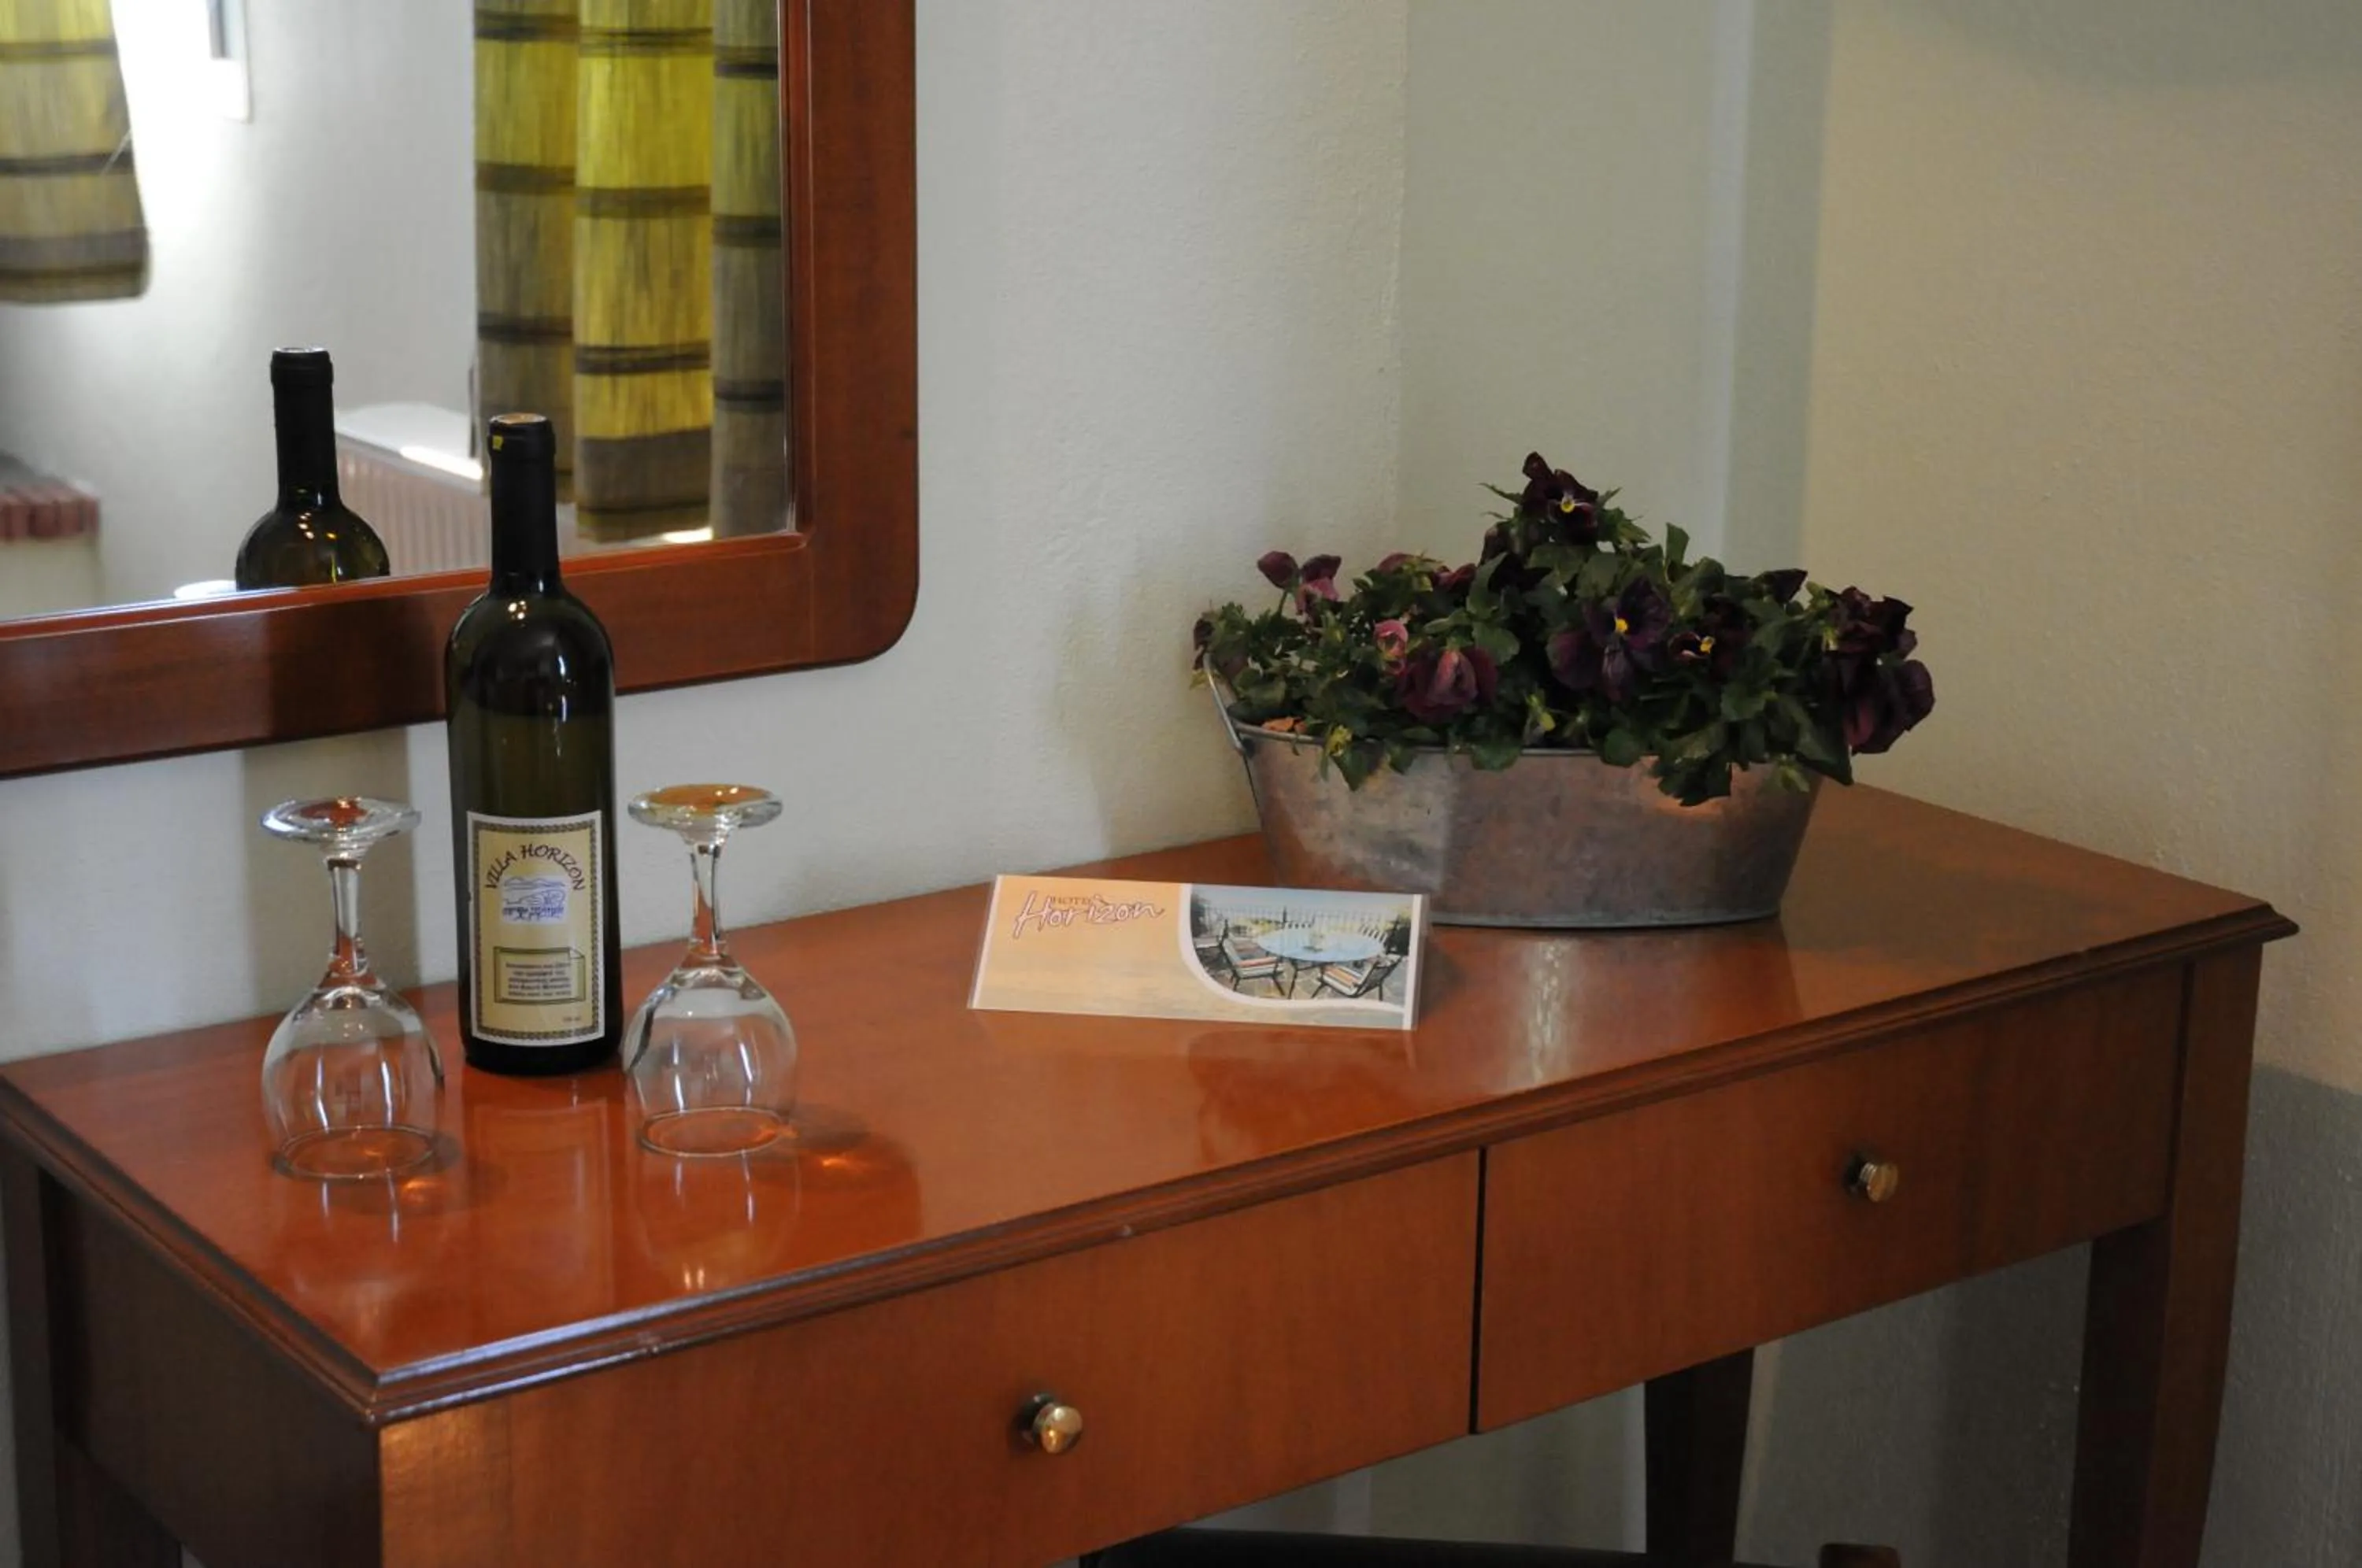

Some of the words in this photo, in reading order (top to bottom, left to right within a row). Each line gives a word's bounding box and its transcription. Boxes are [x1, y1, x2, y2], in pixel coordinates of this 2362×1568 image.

[485, 850, 517, 889] VILLA
[520, 843, 585, 891] HORIZON
[1013, 890, 1165, 939] Horizon
